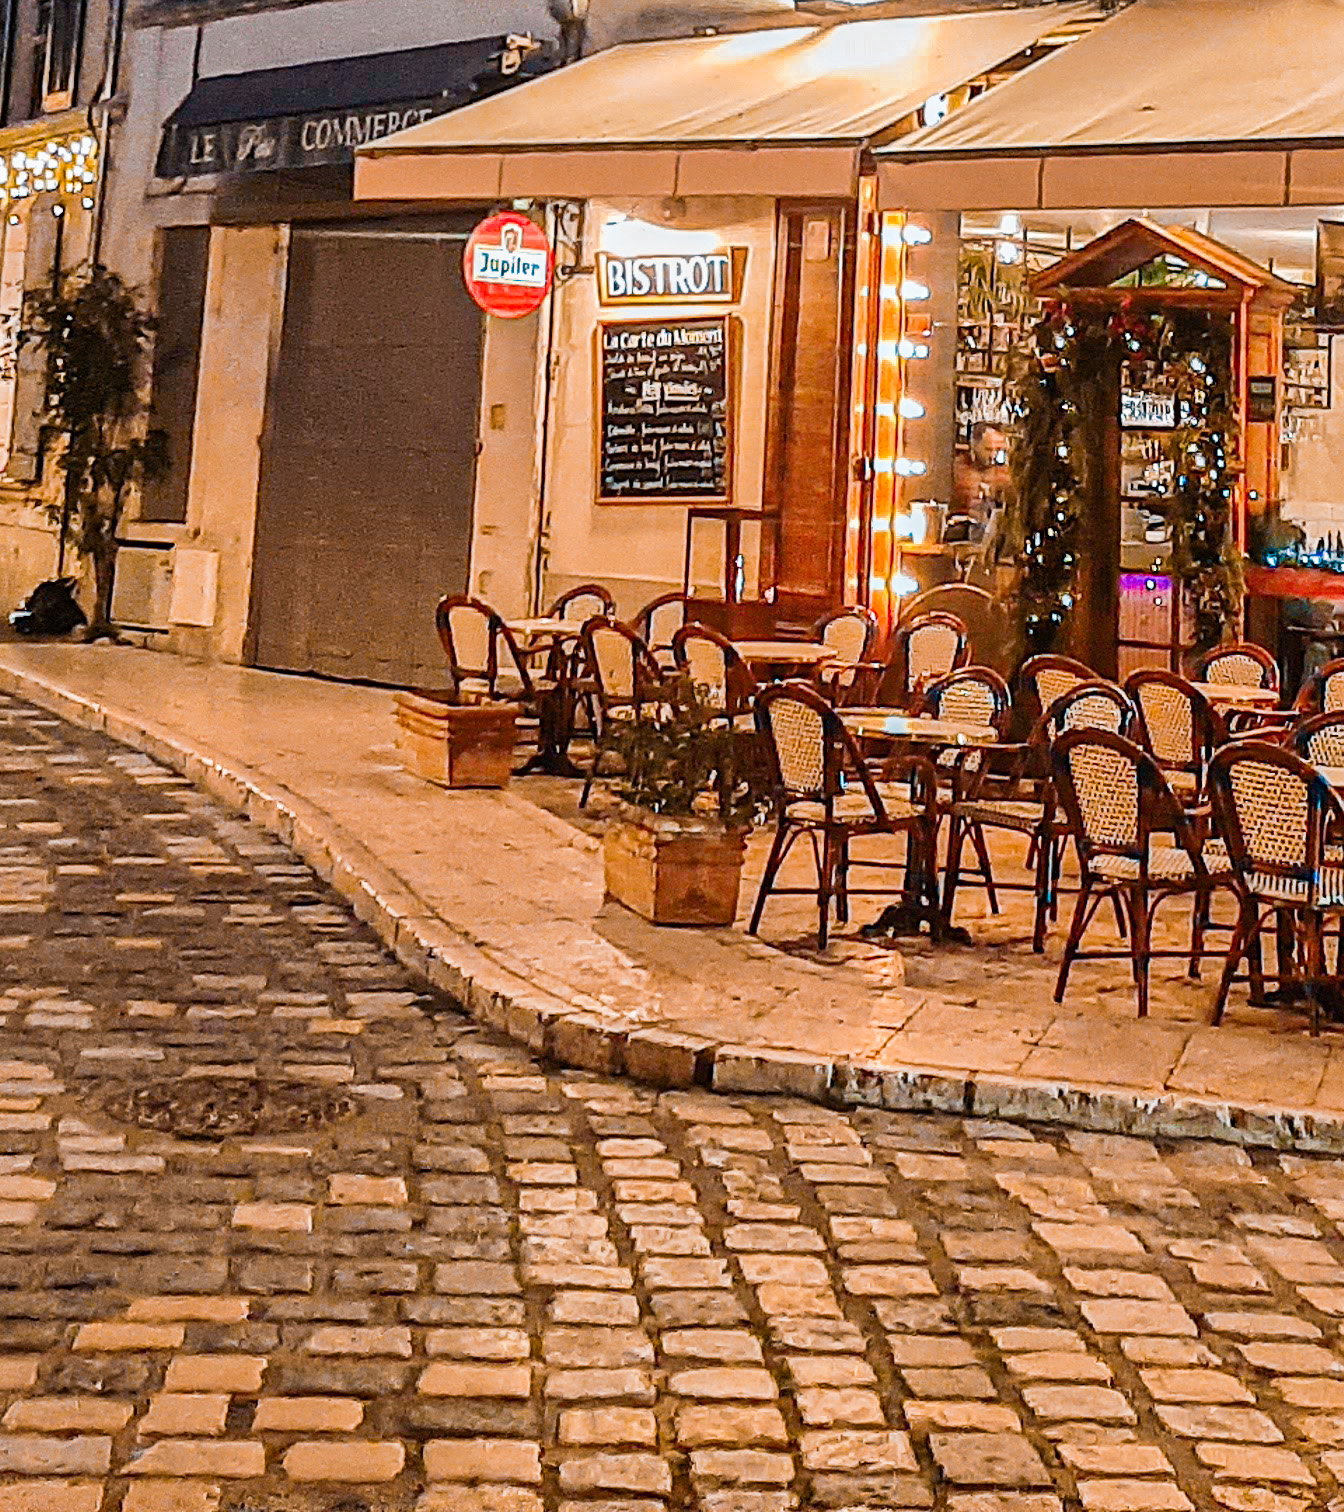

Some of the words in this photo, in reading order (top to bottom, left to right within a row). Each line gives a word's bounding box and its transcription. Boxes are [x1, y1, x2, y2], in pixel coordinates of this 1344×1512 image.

[479, 251, 541, 277] Jupiler
[607, 255, 728, 296] BISTROT
[603, 333, 618, 349] La
[620, 331, 655, 349] Carte
[656, 328, 672, 347] du
[673, 326, 723, 345] Moment
